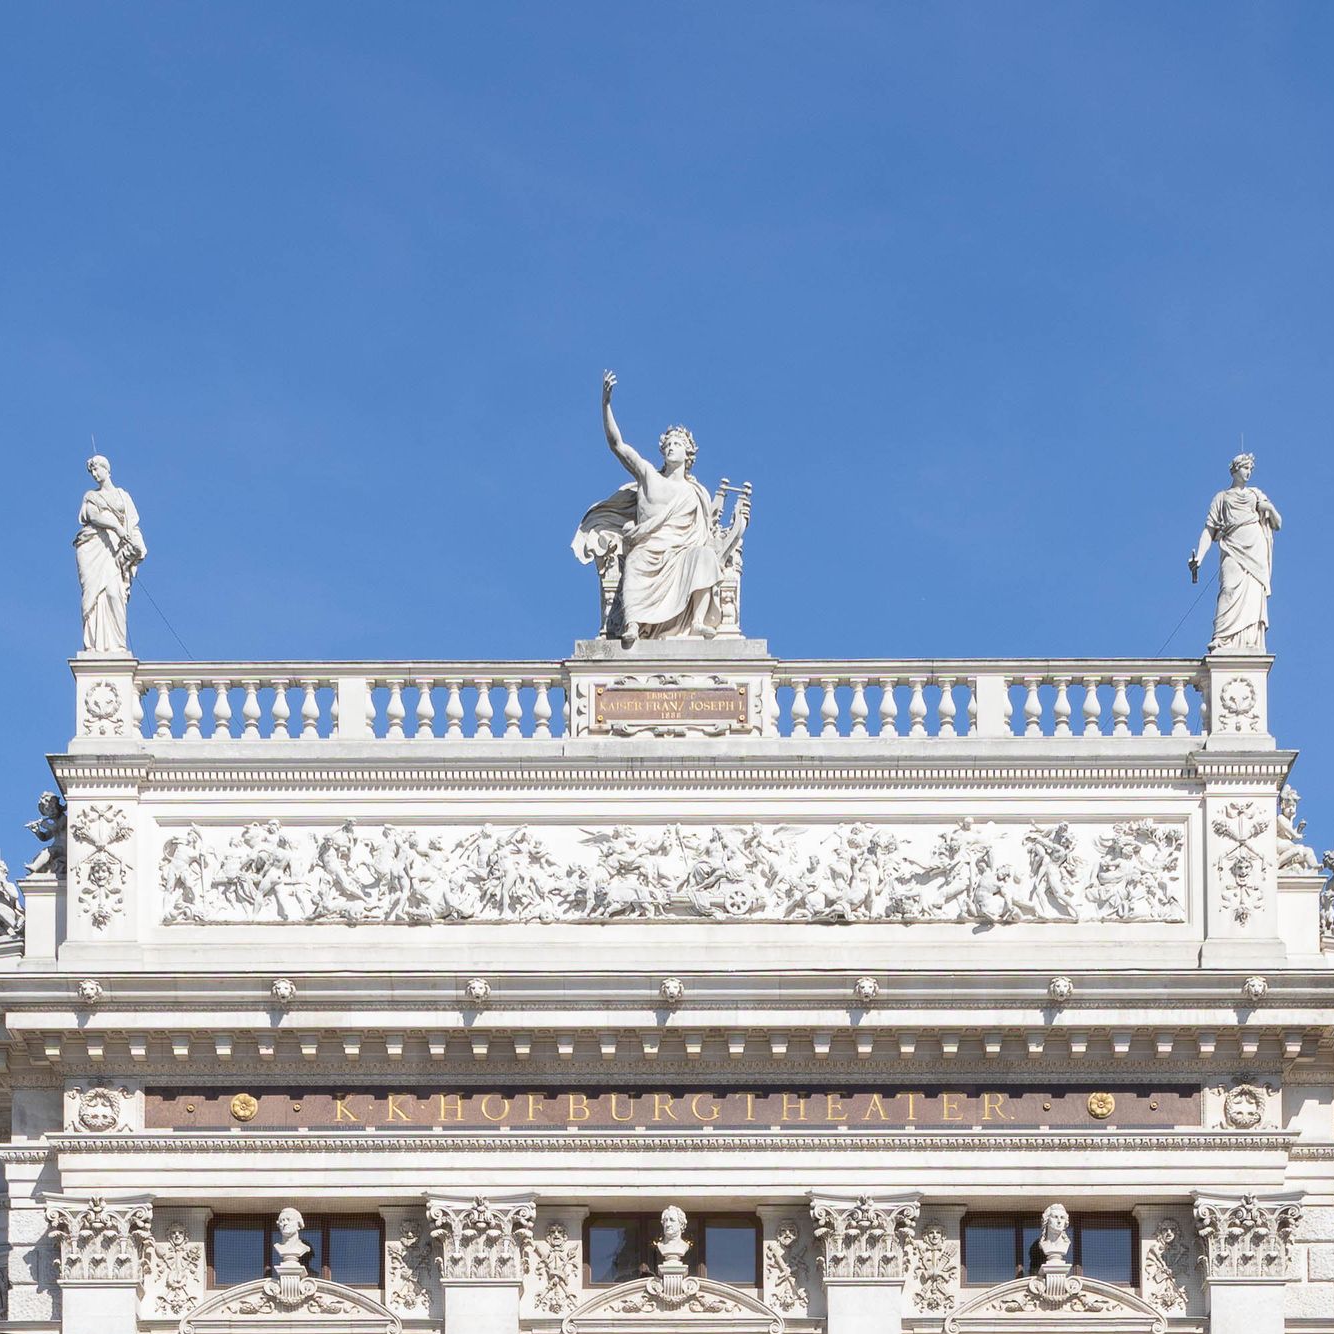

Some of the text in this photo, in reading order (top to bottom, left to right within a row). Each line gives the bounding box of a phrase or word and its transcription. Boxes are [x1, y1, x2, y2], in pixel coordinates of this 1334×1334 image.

[599, 700, 642, 711] KAISER
[647, 700, 685, 711] FRANZ
[688, 700, 734, 711] JOSEPH
